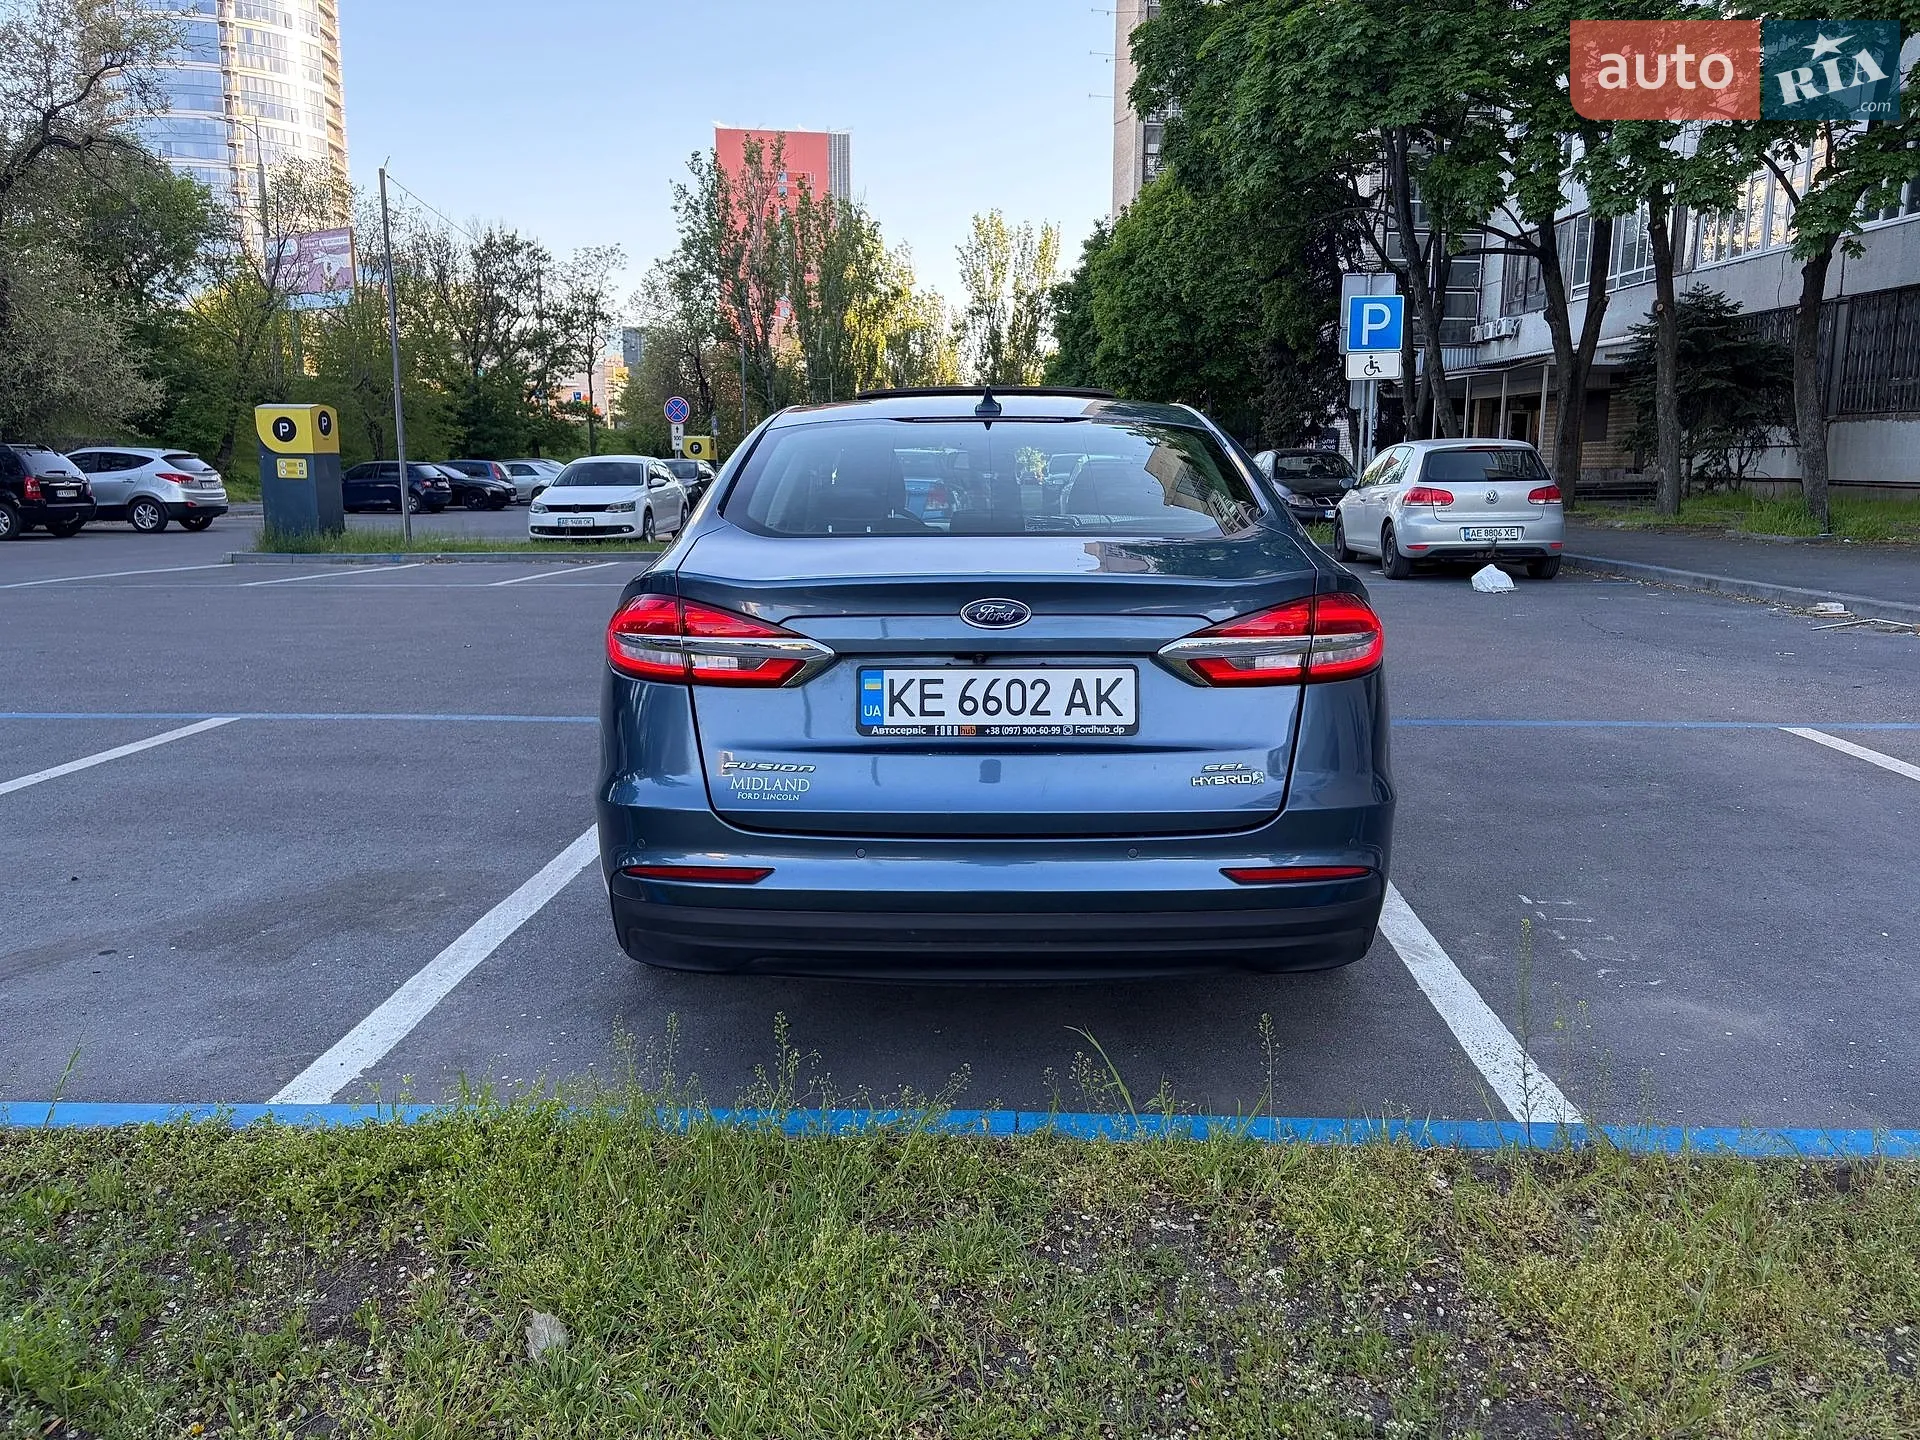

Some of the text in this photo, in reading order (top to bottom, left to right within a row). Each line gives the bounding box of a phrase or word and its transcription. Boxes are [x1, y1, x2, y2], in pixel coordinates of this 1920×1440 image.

[1361, 303, 1391, 346] P
[279, 422, 289, 437] P
[321, 416, 328, 430] P
[692, 444, 699, 452] P
[1471, 529, 1483, 537] AE
[1504, 528, 1516, 537] XE
[976, 604, 1016, 621] Ford
[888, 678, 1124, 717] KE 6602 AK
[864, 705, 881, 717] UA
[871, 725, 927, 736] Автосервіс
[985, 726, 1000, 735] +38
[1001, 726, 1021, 736] (097)
[1022, 726, 1061, 735] 900-60-99
[1075, 725, 1125, 736] Fordhub_dp
[723, 761, 817, 773] FUSION
[1202, 763, 1251, 773] SEL
[730, 777, 810, 792] MIDLAND
[1191, 774, 1252, 787] HYBRID
